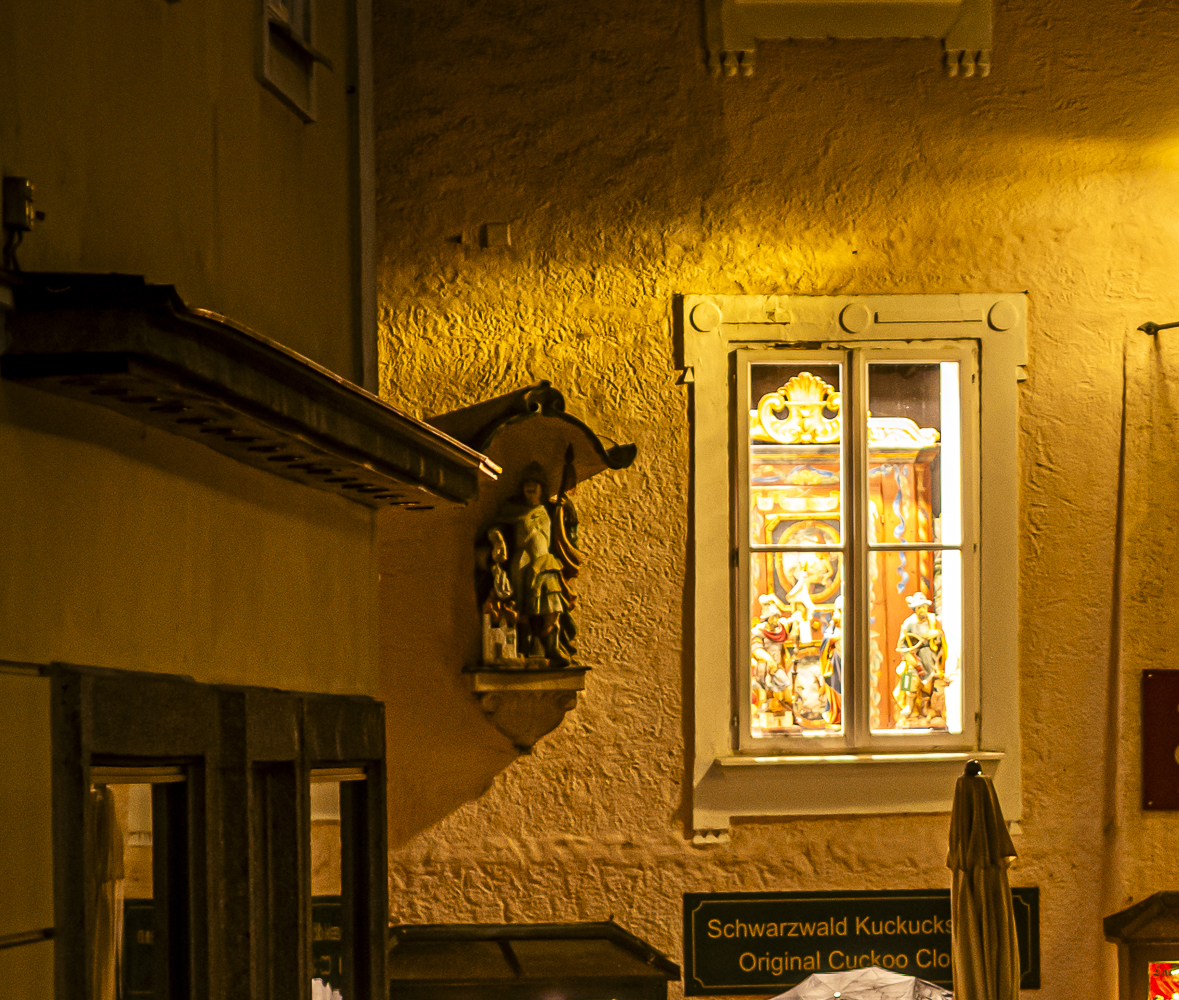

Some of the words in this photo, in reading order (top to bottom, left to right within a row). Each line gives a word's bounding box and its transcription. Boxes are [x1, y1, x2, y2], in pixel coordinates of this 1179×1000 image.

[707, 916, 848, 938] Schwarzwald
[739, 951, 821, 976] Original
[828, 950, 909, 970] Cuckoo
